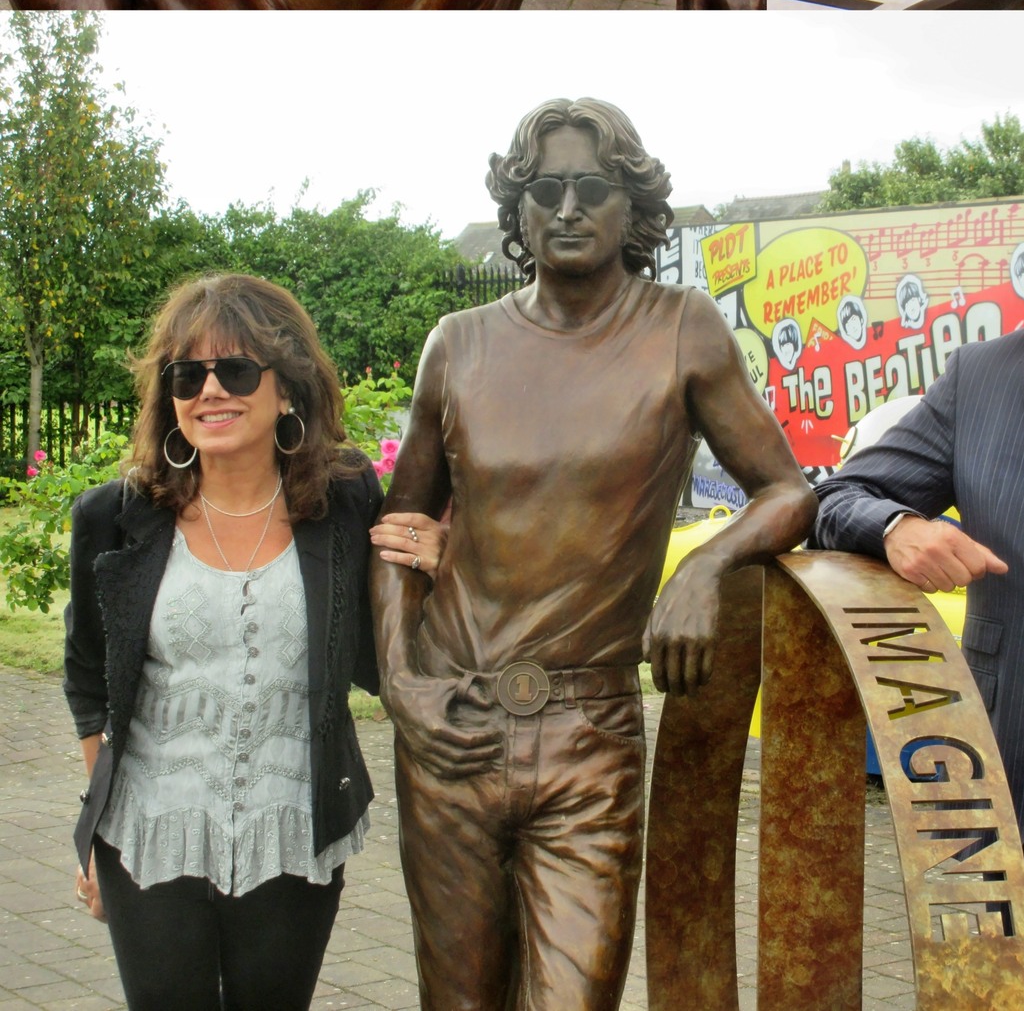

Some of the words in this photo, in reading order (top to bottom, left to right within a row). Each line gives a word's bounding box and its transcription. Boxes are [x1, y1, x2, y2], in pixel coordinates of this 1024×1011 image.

[708, 224, 750, 265] PLDT
[766, 269, 775, 290] A
[779, 251, 824, 286] PLACE
[828, 242, 849, 267] TO
[712, 258, 751, 286] PRESENTS
[842, 606, 1017, 943] IMAGINE
